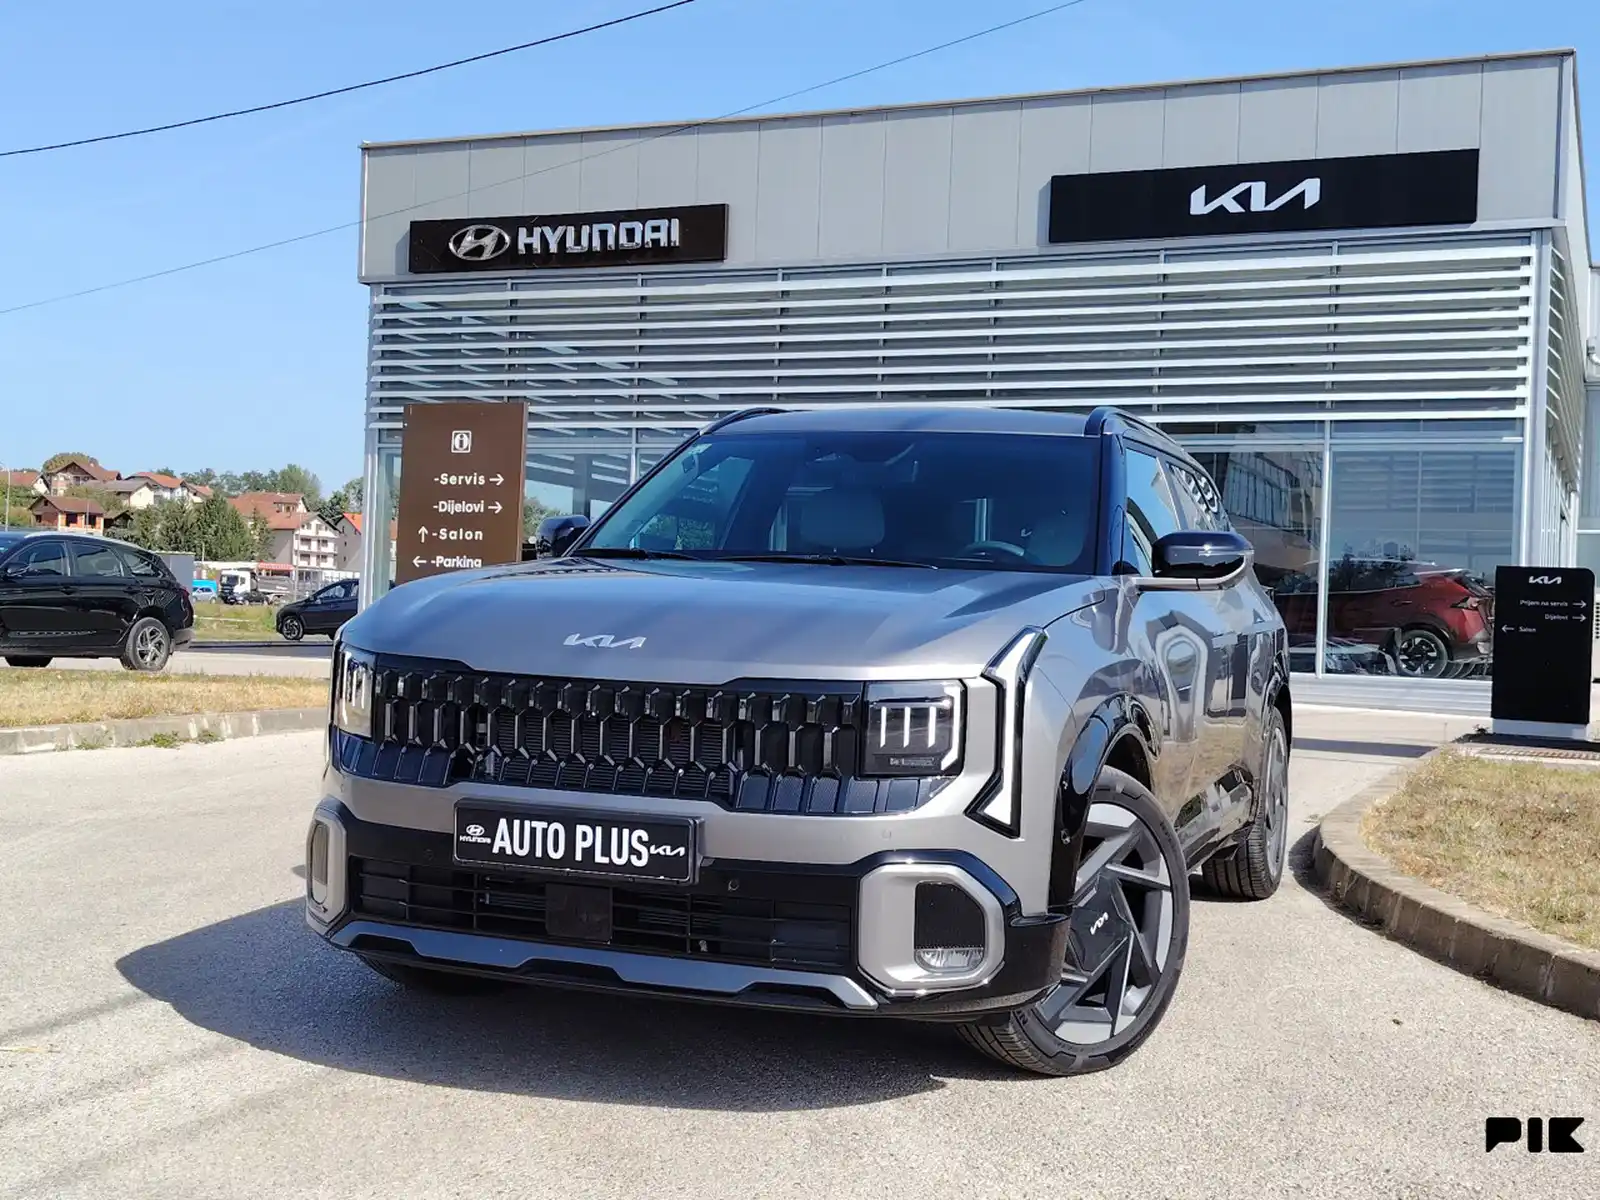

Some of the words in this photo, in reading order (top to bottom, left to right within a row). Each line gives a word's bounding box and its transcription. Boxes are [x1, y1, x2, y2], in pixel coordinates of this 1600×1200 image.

[1189, 177, 1321, 215] KIA
[517, 217, 681, 255] HYUNDAI
[492, 817, 566, 860] AUTO
[574, 824, 650, 868] PLUS
